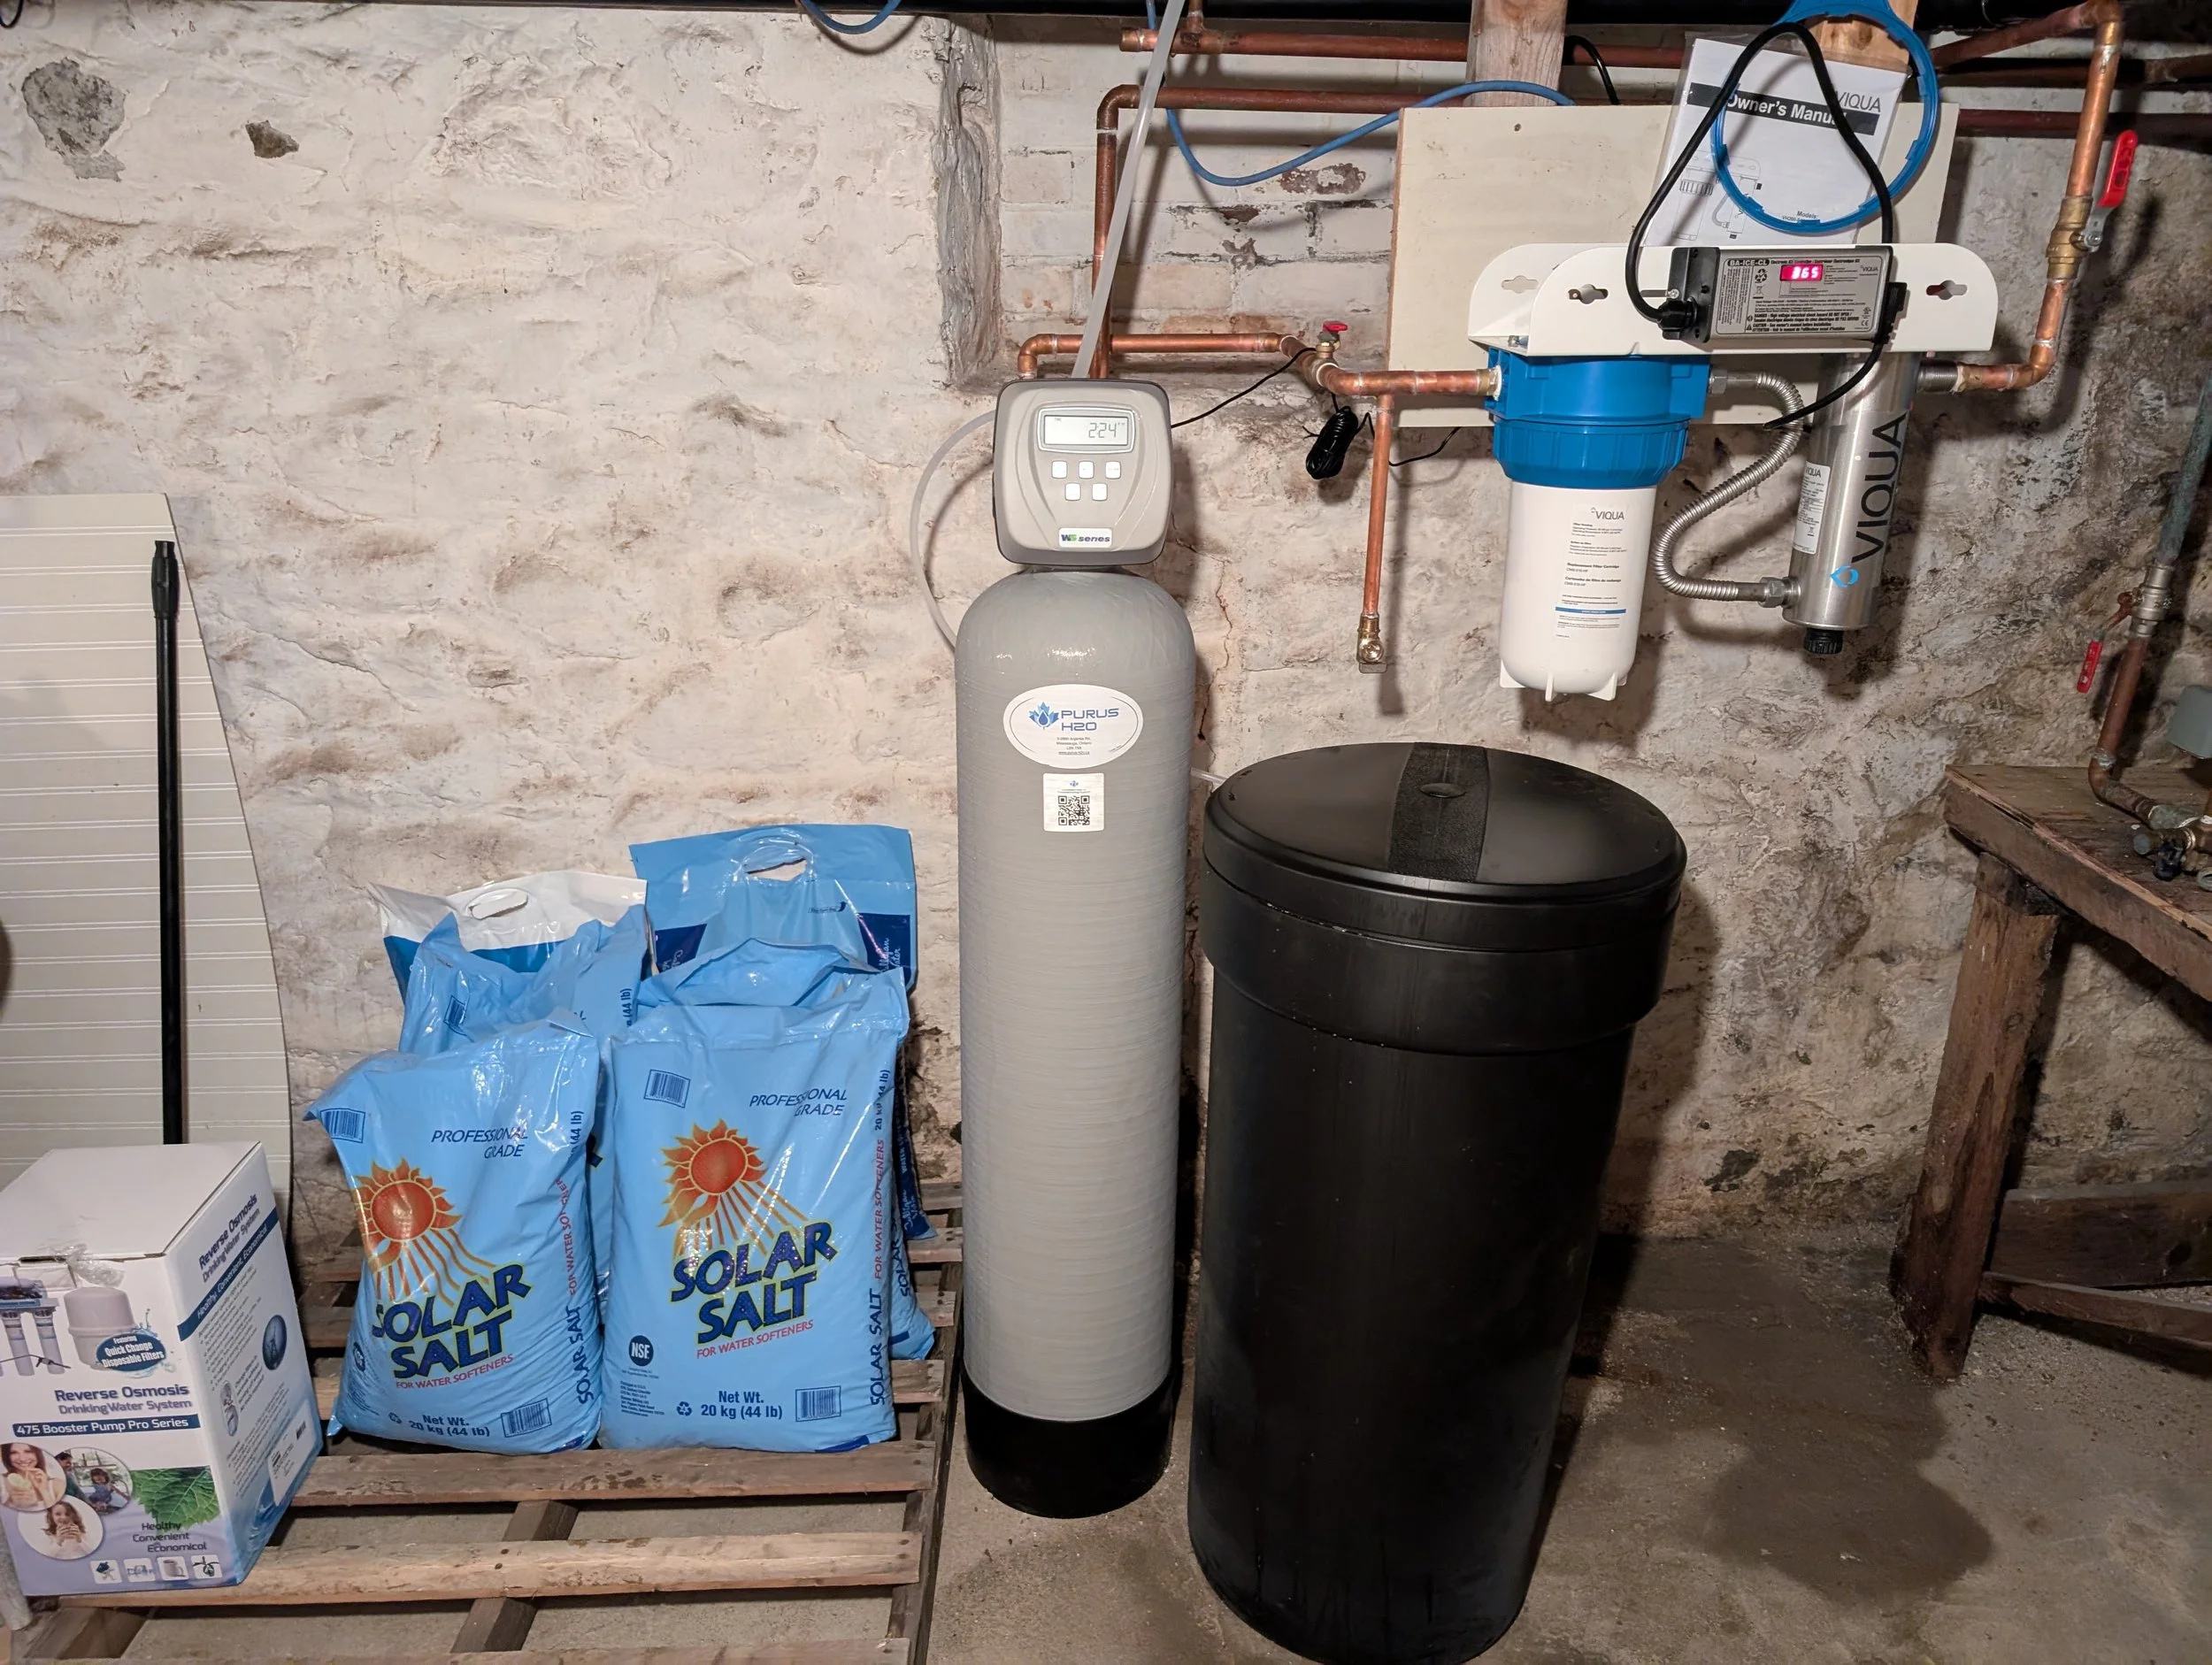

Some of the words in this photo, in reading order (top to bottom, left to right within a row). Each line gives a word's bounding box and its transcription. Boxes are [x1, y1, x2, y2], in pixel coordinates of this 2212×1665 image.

[1727, 95, 1787, 117] Owner's
[1791, 104, 1847, 126] Manu
[1836, 91, 1881, 112] VIQUA
[1851, 412, 1907, 564] VIQUA
[1595, 510, 1624, 520] VIQUA
[1061, 708, 1119, 719] PURUS
[1061, 722, 1097, 732] H2O
[879, 938, 894, 971] ulligan
[431, 1126, 528, 1143] PROFESSIONAL
[484, 1144, 525, 1159] GRADE
[240, 1208, 261, 1236] System
[198, 1229, 229, 1270] Reverse
[228, 1193, 258, 1233] Osmosis
[565, 1231, 575, 1272] WATER
[671, 1222, 839, 1302] SOLAR
[567, 1275, 577, 1296] FOR
[697, 1270, 818, 1345] SALT
[869, 1287, 883, 1336] SALT
[391, 1309, 512, 1379] SALT
[696, 1347, 717, 1360] FOR
[718, 1337, 755, 1354] WATER
[756, 1319, 814, 1346] SOFTENERS
[104, 1345, 127, 1357] Quick
[125, 1341, 154, 1354] Change
[631, 1342, 650, 1360] NSF
[101, 1354, 142, 1368] Disposable
[141, 1350, 165, 1362] Filters
[396, 1380, 414, 1389] FOR
[417, 1377, 452, 1389] WATER
[453, 1353, 514, 1384] SOFTENERS
[870, 1342, 885, 1406] SOLAR
[54, 1389, 119, 1402] Reverse
[121, 1384, 190, 1399] Osmosis
[718, 1391, 741, 1403] Net
[743, 1392, 764, 1403] Wt.
[146, 1400, 193, 1412] System
[701, 1404, 718, 1416] 20
[720, 1405, 737, 1419] kg
[741, 1406, 763, 1420] (44
[765, 1406, 783, 1420] lb)
[17, 1425, 41, 1435] 475
[42, 1423, 88, 1435] Booster
[91, 1421, 127, 1433] Pump
[128, 1420, 150, 1431] Pro
[152, 1417, 189, 1429] Series
[409, 1420, 425, 1431] 20
[427, 1425, 443, 1436] kg
[447, 1426, 468, 1437] (44
[472, 1426, 490, 1438] lb)
[422, 1414, 444, 1425] Net
[447, 1416, 470, 1426] Wt.
[142, 1521, 182, 1531] Healthy
[133, 1532, 190, 1543] Convenient
[147, 1541, 207, 1553] Economical
